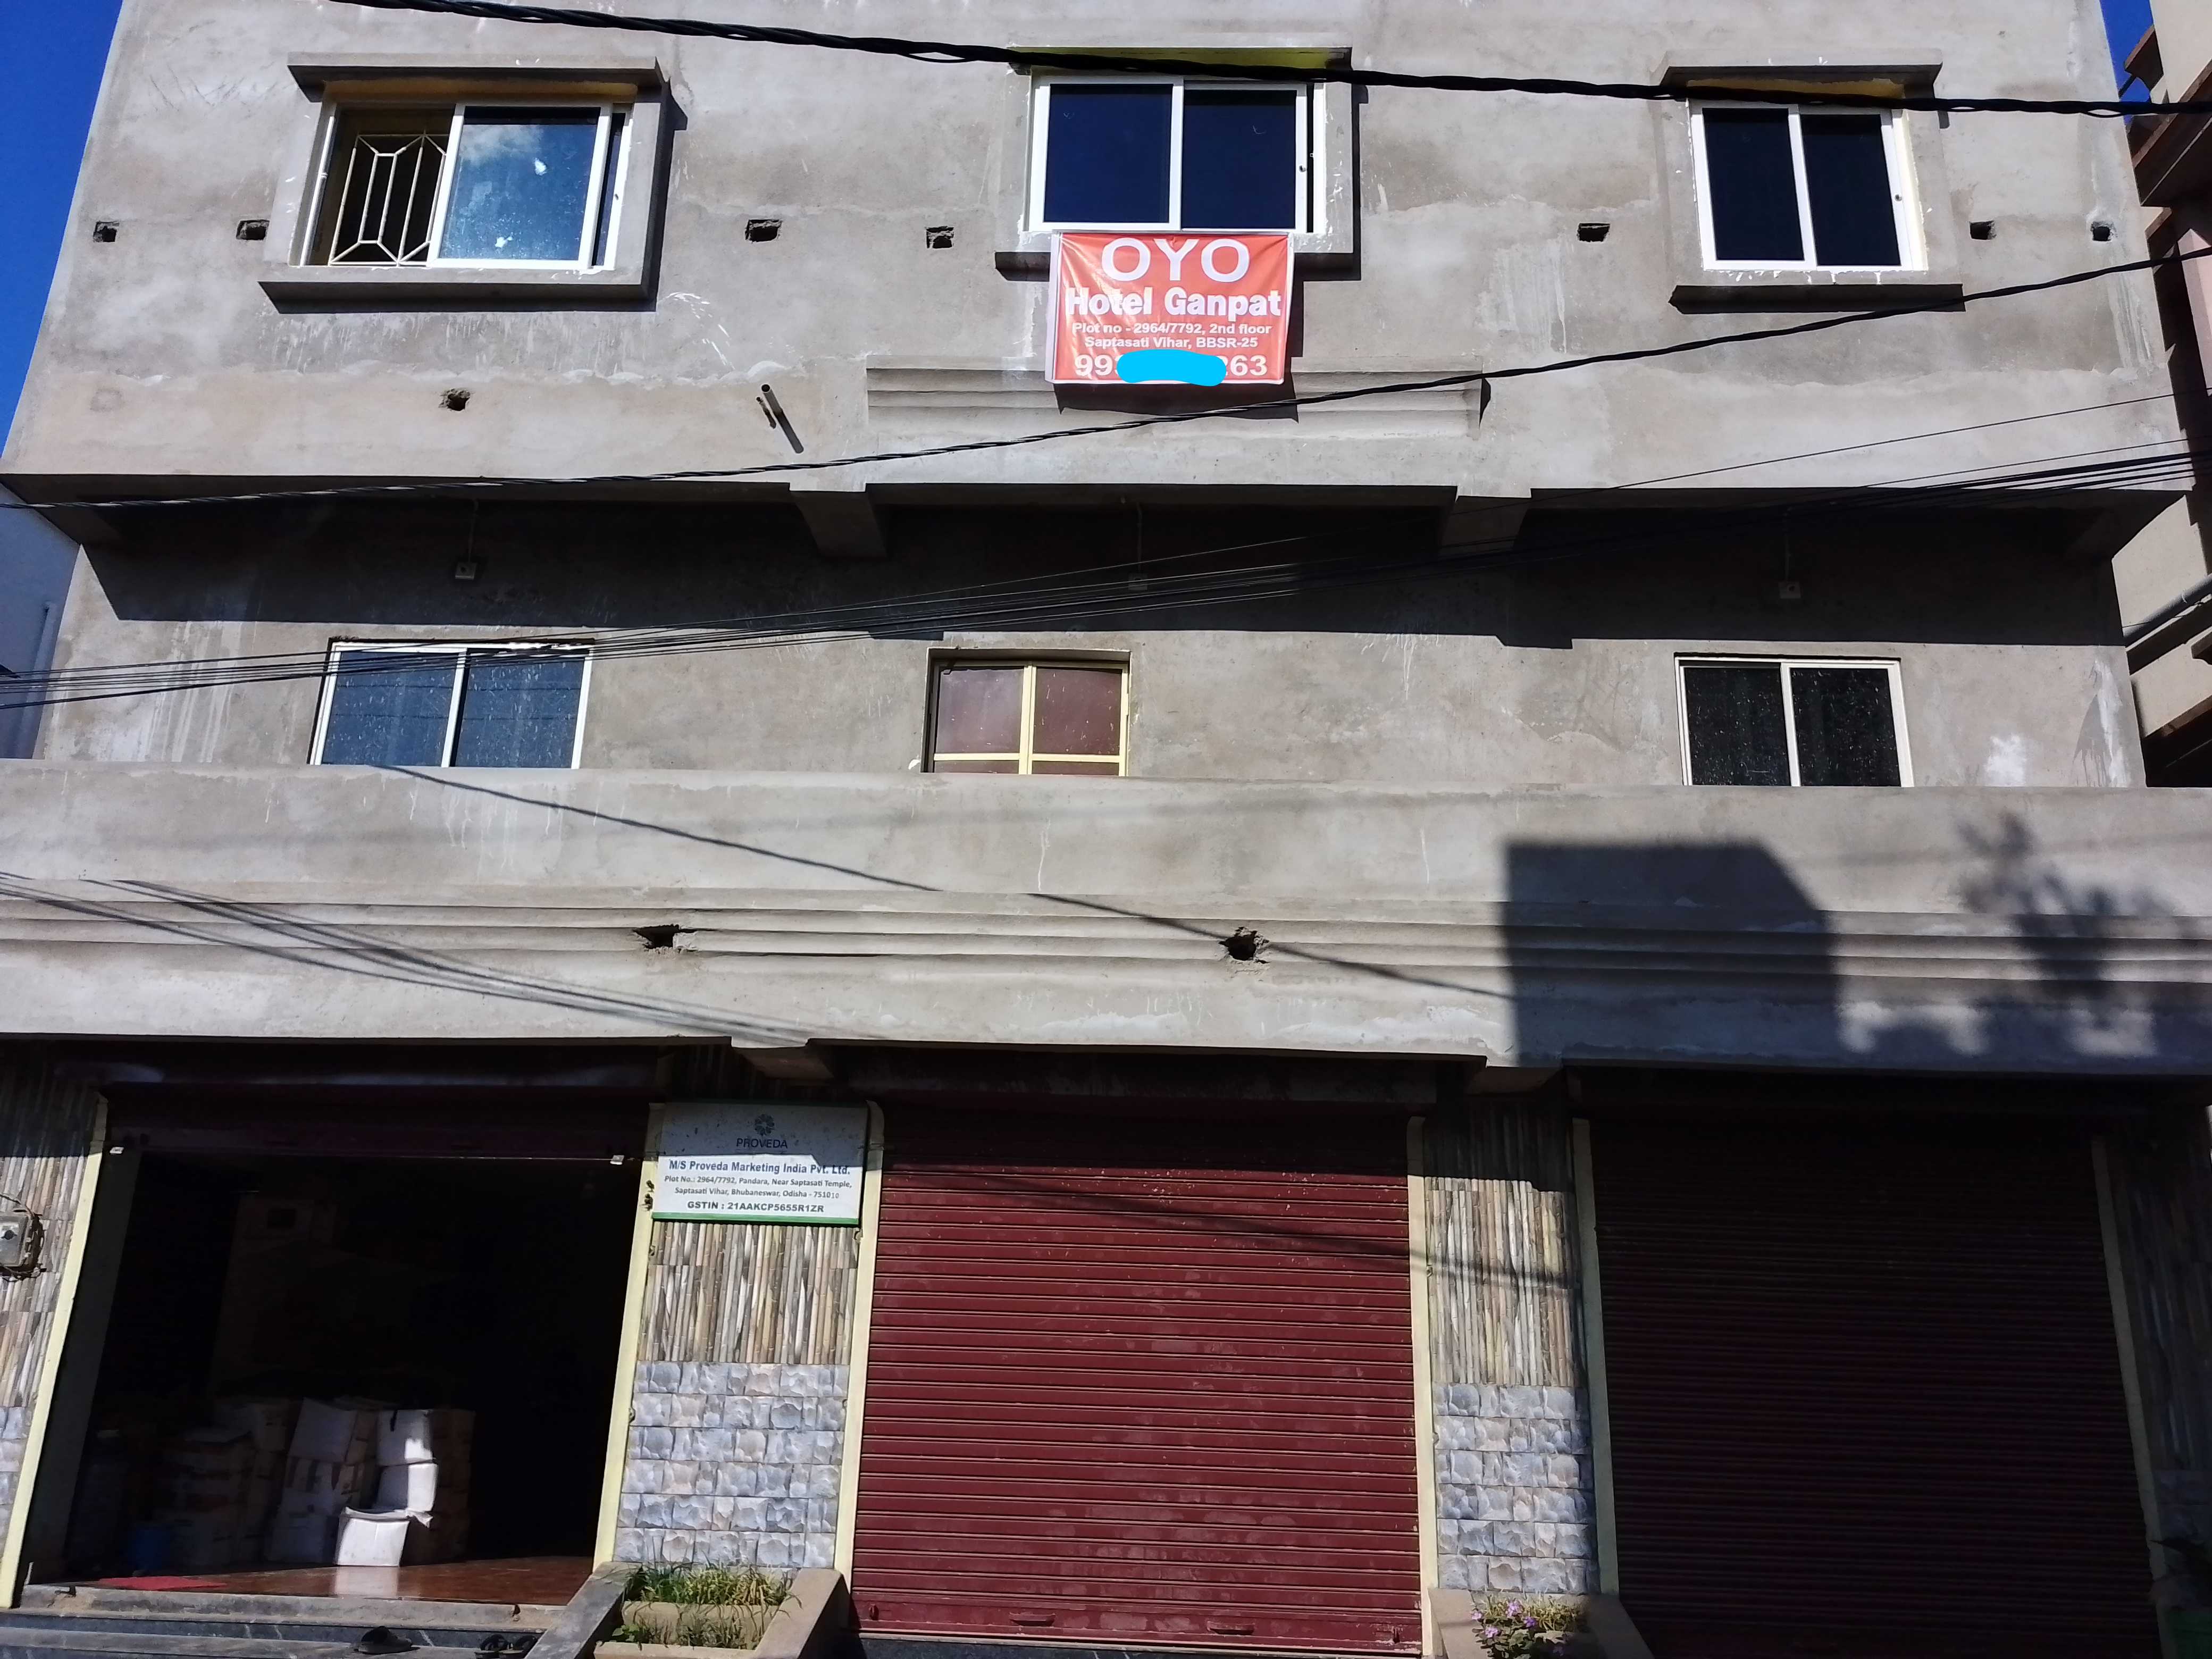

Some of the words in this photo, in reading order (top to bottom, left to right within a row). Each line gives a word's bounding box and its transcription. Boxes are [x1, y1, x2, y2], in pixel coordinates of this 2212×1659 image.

[1101, 237, 1250, 282] OYO
[1066, 287, 1152, 315] Hotel
[1164, 287, 1281, 322] Ganpat
[1072, 322, 1100, 333] Plot
[1103, 325, 1122, 333] no
[1134, 323, 1205, 335] 2964/7792,
[1210, 323, 1235, 334] 2nd
[1238, 323, 1272, 334] floor
[1085, 336, 1149, 349] Saptasati
[1153, 337, 1192, 349] Vihar,
[1196, 337, 1258, 348] BBSR-25
[736, 1138, 787, 1149] PROVEDA
[669, 1160, 686, 1170] M/S
[690, 1161, 728, 1170] Proveda
[732, 1162, 780, 1175] Marketing
[783, 1163, 807, 1173] India
[810, 1164, 828, 1174] Pvt.
[832, 1164, 850, 1175] Ltd.
[697, 1176, 737, 1185] 2964/7792,
[790, 1178, 823, 1187] Saptasati
[675, 1187, 707, 1195] Saptasati
[731, 1188, 781, 1197] Bhubaneswar,
[727, 1202, 824, 1212] 21AAKCP5655R1ZR
